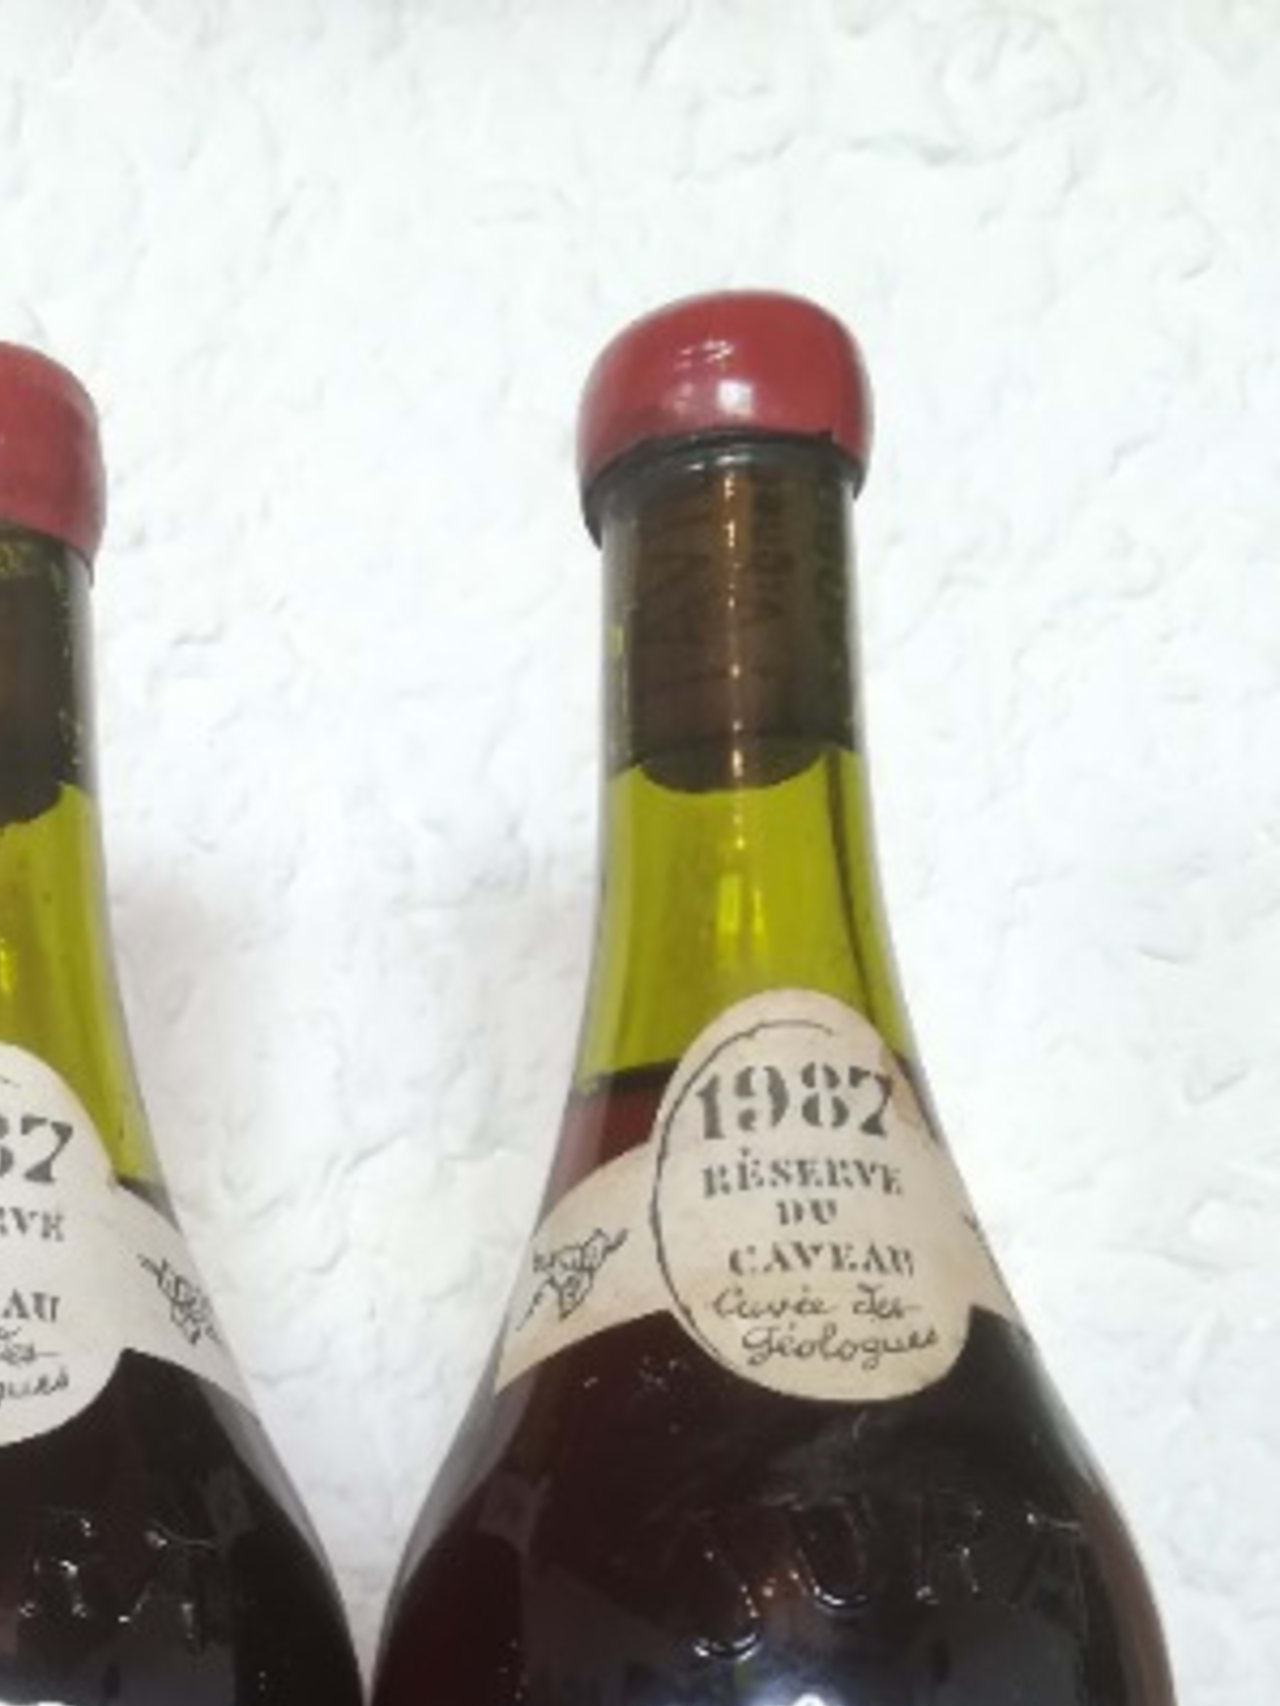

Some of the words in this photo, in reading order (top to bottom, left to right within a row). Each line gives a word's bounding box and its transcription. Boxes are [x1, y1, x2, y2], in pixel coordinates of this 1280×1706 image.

[695, 1061, 893, 1140] 1987
[776, 1198, 837, 1225] DU
[728, 1240, 914, 1276] CAVEAU
[713, 1284, 839, 1319] Cuvée
[741, 1322, 938, 1371] Géologues
